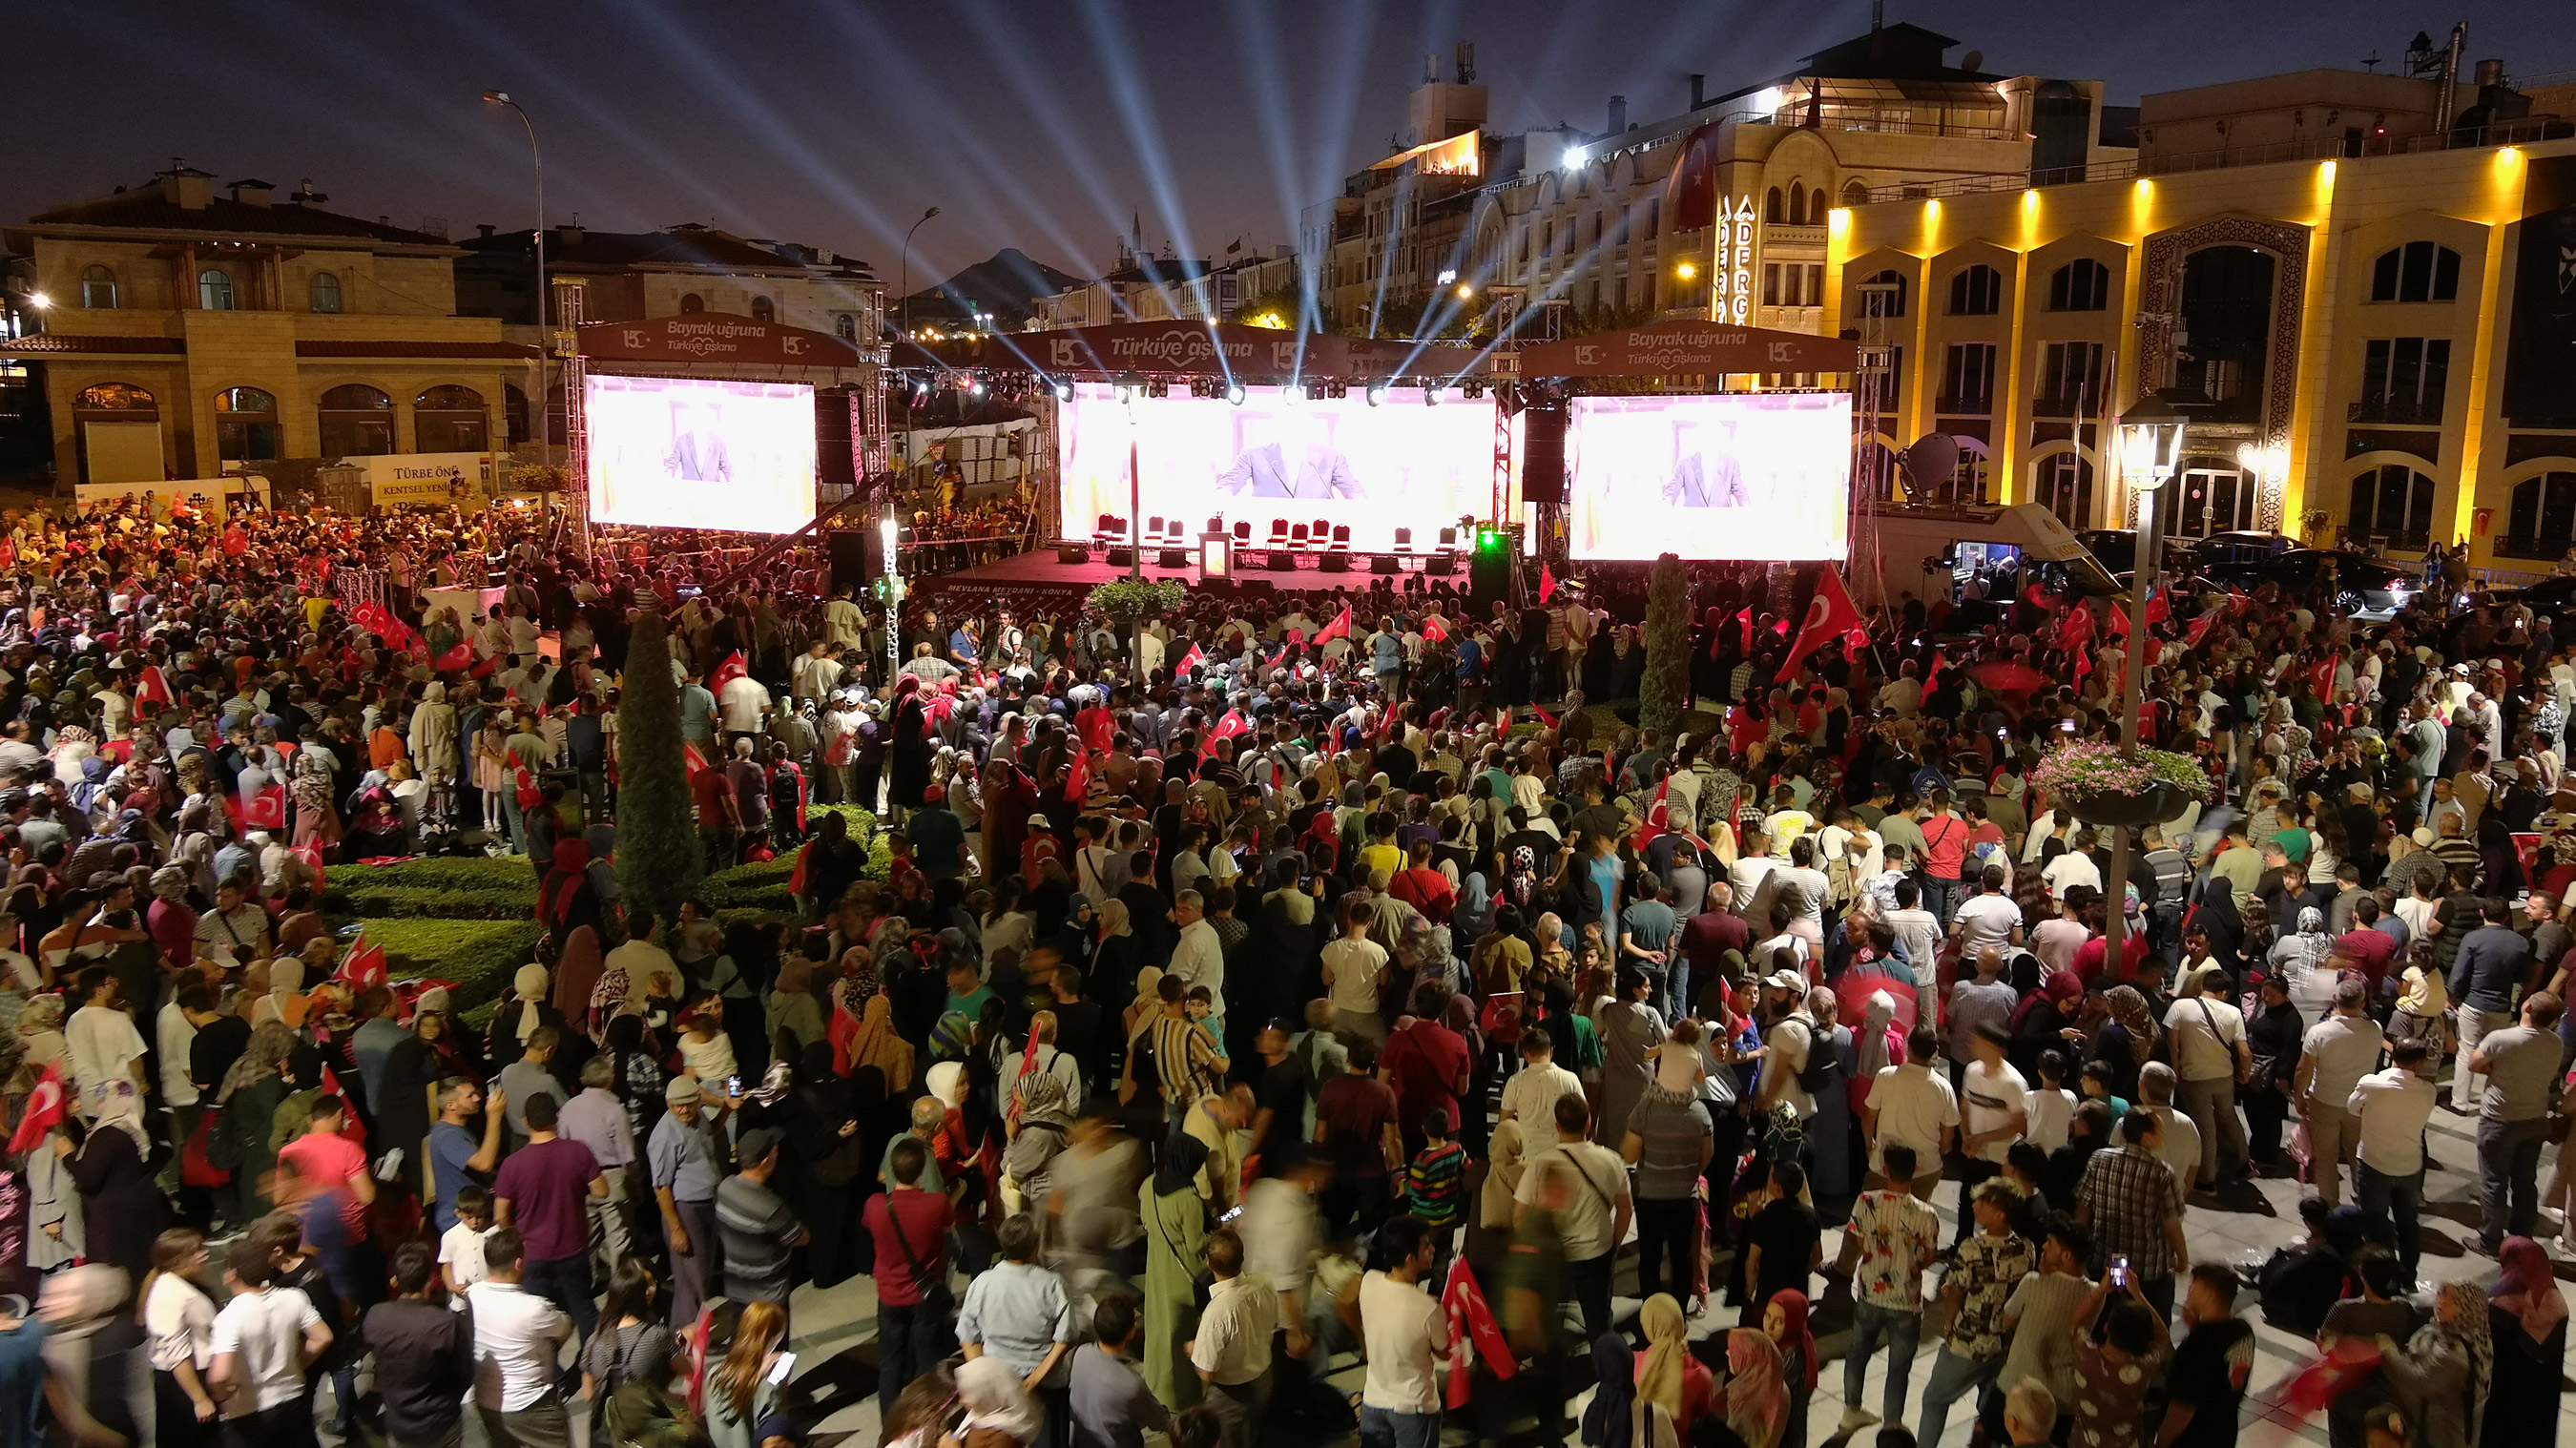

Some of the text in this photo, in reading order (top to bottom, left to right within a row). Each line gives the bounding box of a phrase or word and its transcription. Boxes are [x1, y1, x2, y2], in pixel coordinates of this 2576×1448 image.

[668, 321, 765, 338] Bayrak uğruna
[1628, 329, 1747, 349] Bayrak uğruna
[668, 340, 737, 353] Türkiye aşkına
[1111, 338, 1253, 360] Türkiye aşkına
[1628, 352, 1712, 366] Türkiye aşkına
[393, 465, 459, 479] TÜRBE ÖNÜ
[384, 482, 453, 495] KENTSEL YENİL
[947, 585, 990, 593] MEVLANA
[992, 586, 1035, 595] MEYDANI
[1041, 588, 1072, 596] KONYA
